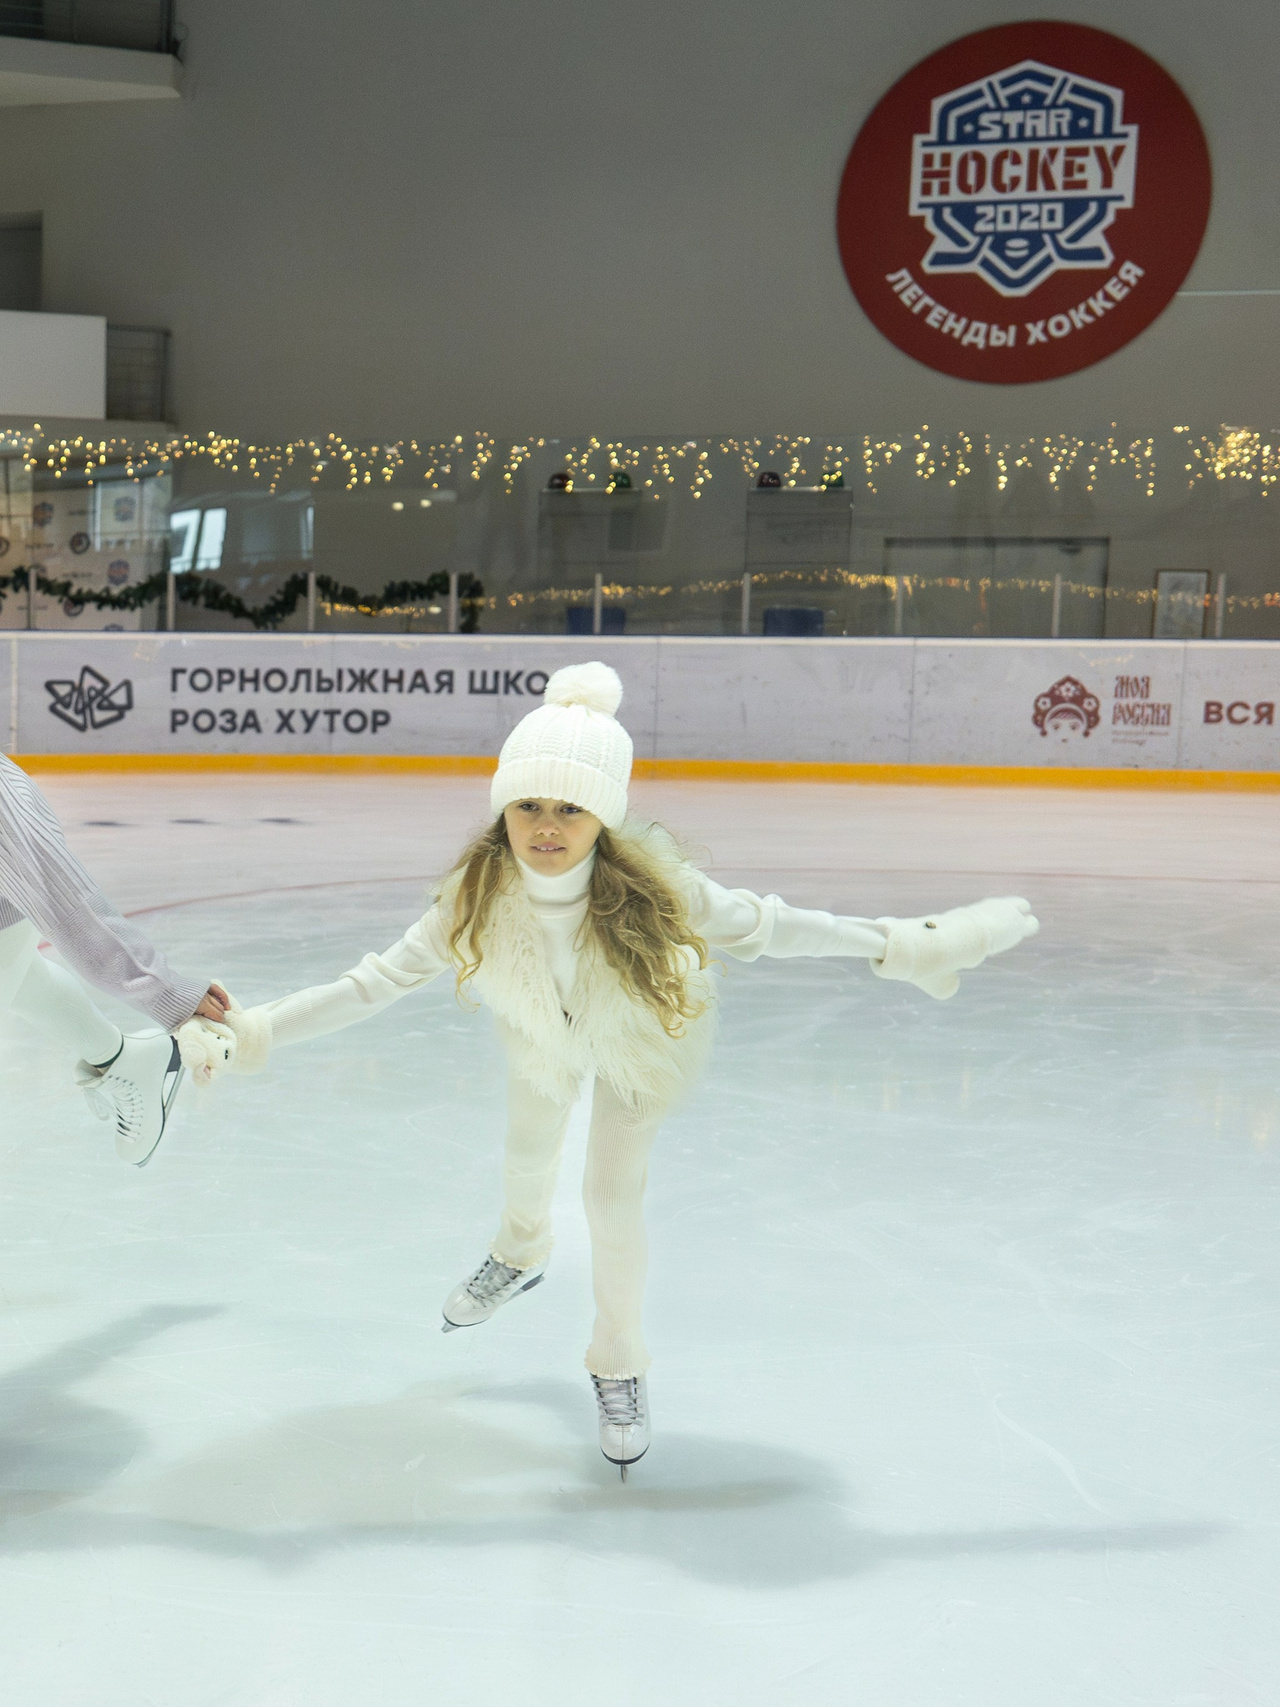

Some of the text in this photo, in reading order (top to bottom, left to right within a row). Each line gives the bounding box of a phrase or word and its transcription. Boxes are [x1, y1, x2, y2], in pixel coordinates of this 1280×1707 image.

[976, 107, 1072, 141] STAR
[920, 144, 1127, 197] HOCKEY
[973, 202, 1065, 232] 2020
[885, 259, 1146, 350] ЛЕГЕНДЫ ХОККЕЯ
[169, 667, 550, 696] ГОРНОЛЫЖНАЯ ШКО
[169, 708, 392, 735] РОЗА ХУТОР
[1203, 701, 1276, 726] ВСЯ
